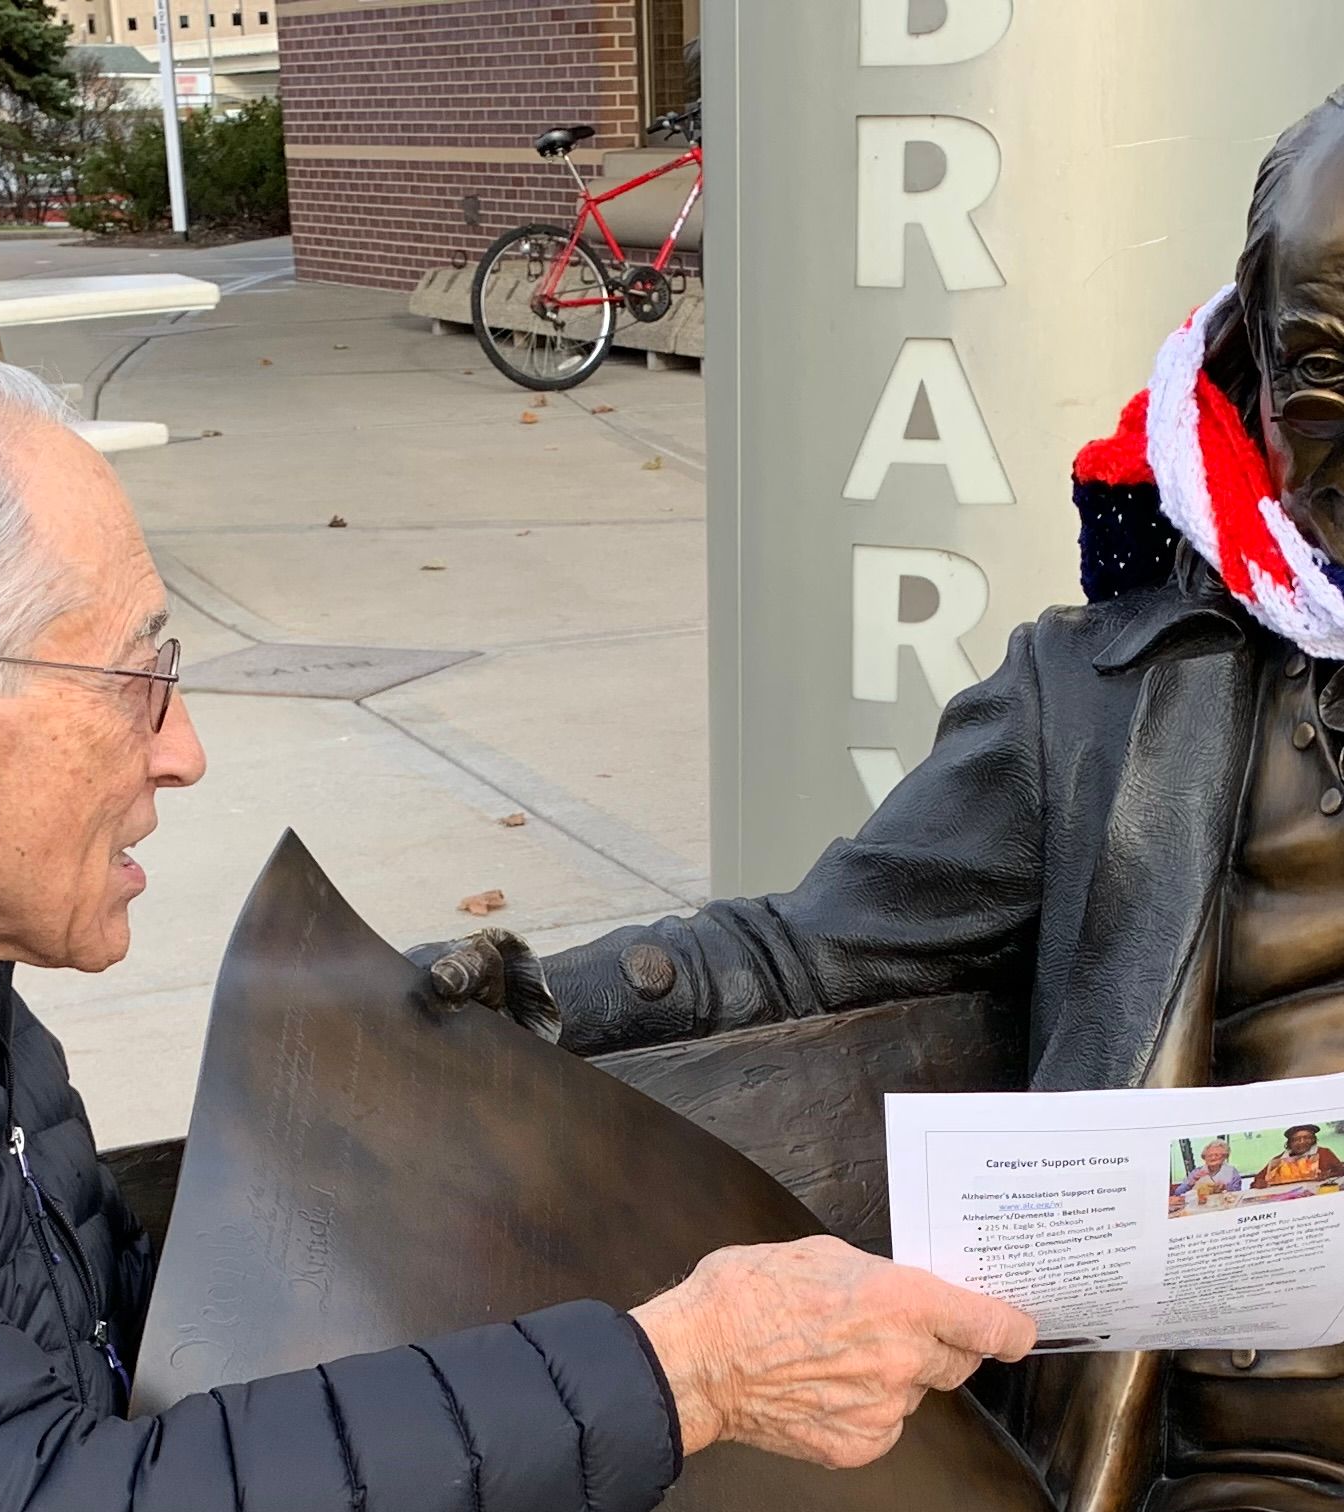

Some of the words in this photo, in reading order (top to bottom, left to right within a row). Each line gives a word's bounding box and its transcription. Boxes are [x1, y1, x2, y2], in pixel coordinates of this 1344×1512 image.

[985, 1158, 1038, 1170] Caregiver
[1040, 1157, 1086, 1169] Support
[1088, 1155, 1130, 1166] Groups
[961, 1191, 1010, 1201] Alzheimer's
[1011, 1190, 1059, 1200] Association
[1060, 1188, 1095, 1198] Support
[1096, 1186, 1127, 1195] Groups
[962, 1211, 1055, 1222] Alzheimer's/Dementia
[1062, 1206, 1089, 1217] Bethel
[1090, 1205, 1116, 1214] Home
[1236, 1211, 1277, 1225] SPARK!
[1013, 1221, 1035, 1231] Eagle
[1049, 1217, 1084, 1228] Oshkosh
[997, 1232, 1034, 1242] Thursday
[1035, 1231, 1045, 1239] of
[1046, 1229, 1066, 1238] each
[1067, 1225, 1095, 1235] month
[963, 1245, 1002, 1254] Caregiver
[1035, 1236, 1082, 1248] Community
[1084, 1231, 1113, 1241] Church
[1037, 1246, 1072, 1257] Oshkosh
[1000, 1259, 1035, 1270] Thursday
[1047, 1255, 1066, 1264] each
[965, 1273, 1004, 1282] Caregiver
[1035, 1263, 1063, 1273] Virtual
